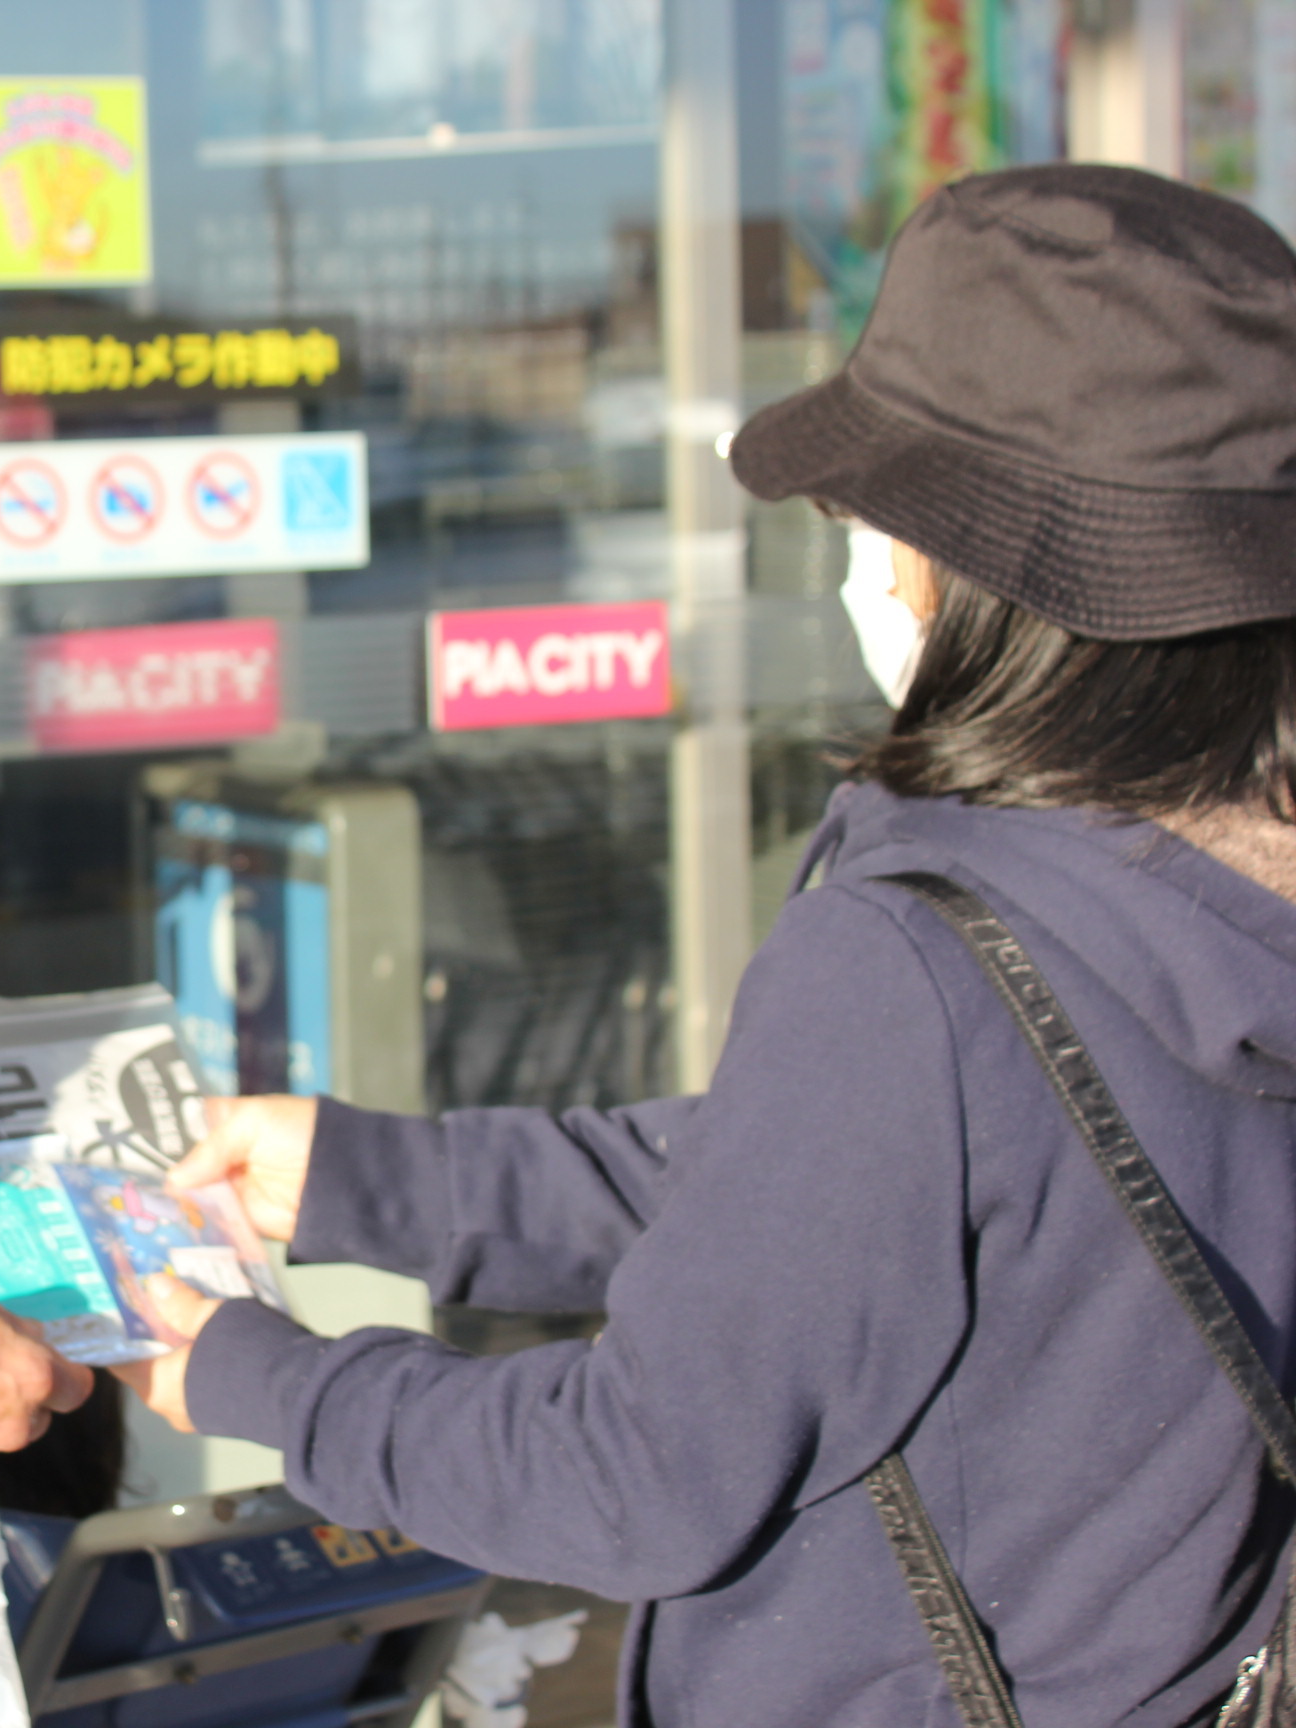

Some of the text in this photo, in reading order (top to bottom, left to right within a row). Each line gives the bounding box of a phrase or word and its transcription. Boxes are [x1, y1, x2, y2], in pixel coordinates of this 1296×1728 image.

[1, 330, 339, 394] 防犯カメラ作動中
